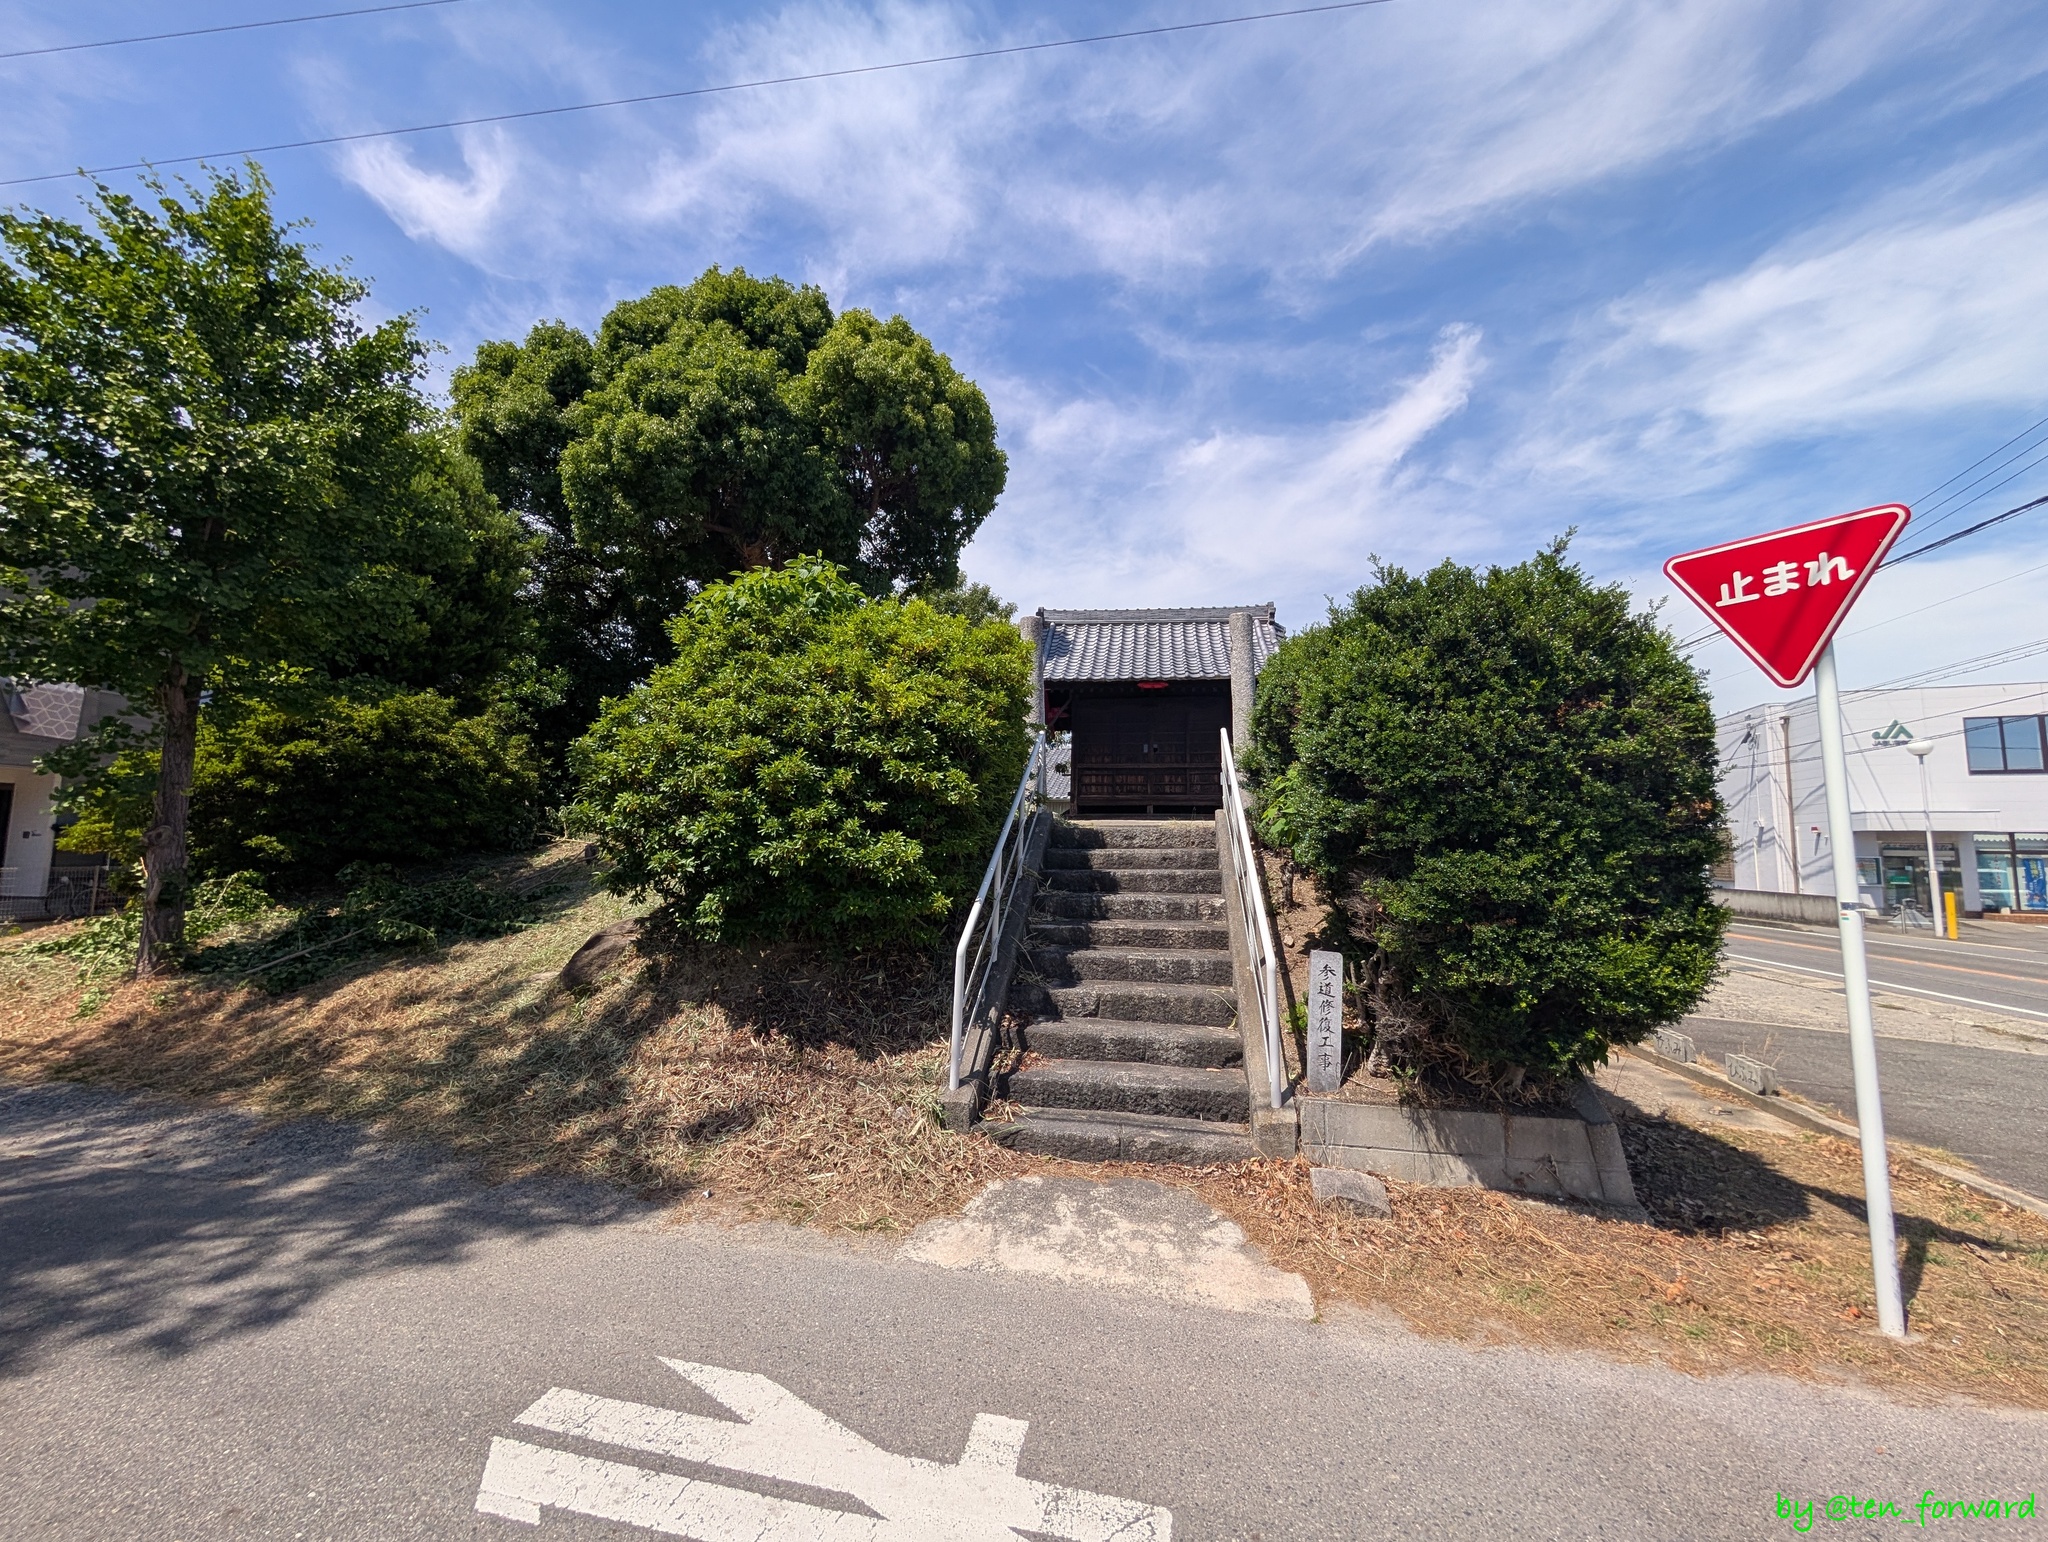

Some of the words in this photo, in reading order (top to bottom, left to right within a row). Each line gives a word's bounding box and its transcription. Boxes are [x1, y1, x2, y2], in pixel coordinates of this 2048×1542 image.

[1715, 552, 1855, 607] 止まれ
[1317, 963, 1337, 1071] 参道修復工事
